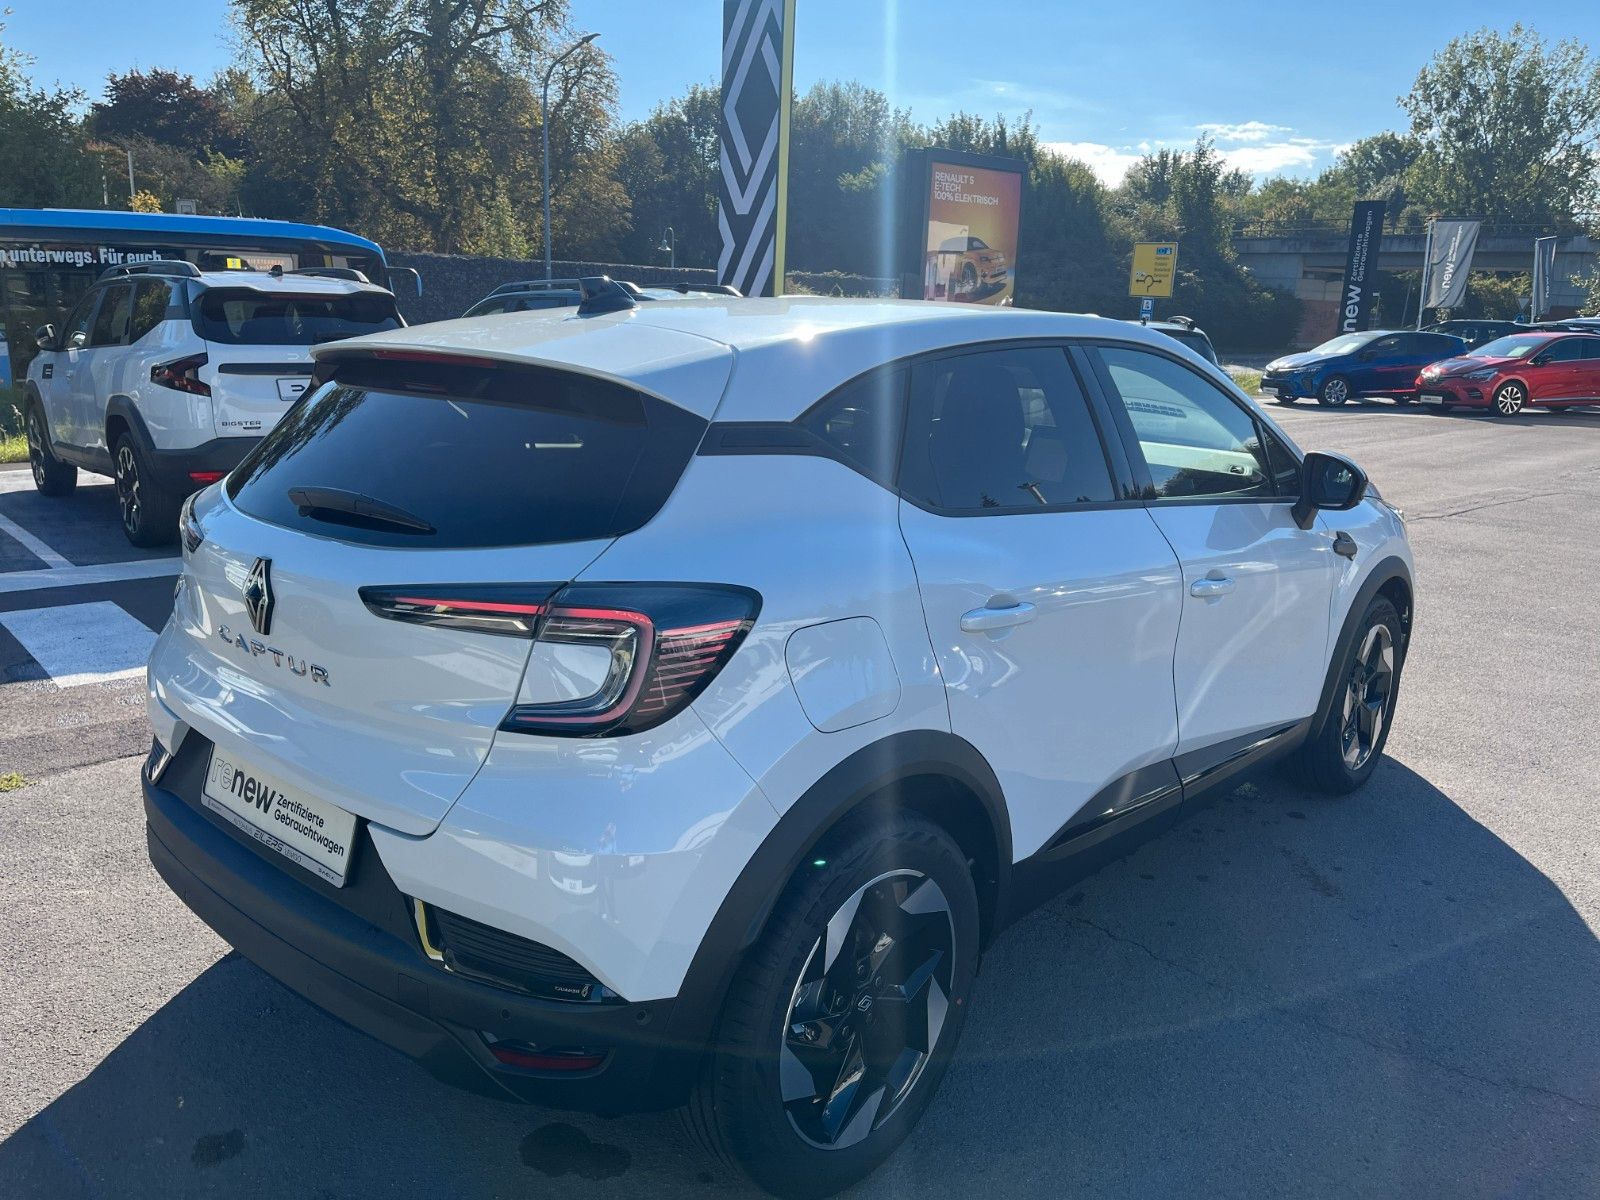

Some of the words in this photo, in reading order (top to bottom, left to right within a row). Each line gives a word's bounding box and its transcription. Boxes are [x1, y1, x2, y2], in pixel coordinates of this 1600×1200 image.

[935, 171, 968, 184] RENAULT
[933, 190, 954, 202] 100%
[954, 193, 999, 206] ELEKTRISCH
[10, 247, 97, 267] unterwegs.
[99, 247, 124, 265] Für
[1357, 210, 1373, 282] Gebrauchtwagen
[218, 624, 331, 687] CAPTUR
[211, 757, 277, 814] renew
[276, 793, 325, 828] Zertifizierte
[252, 829, 284, 853] EILERS
[274, 808, 345, 857] Gebrauchtwagen
